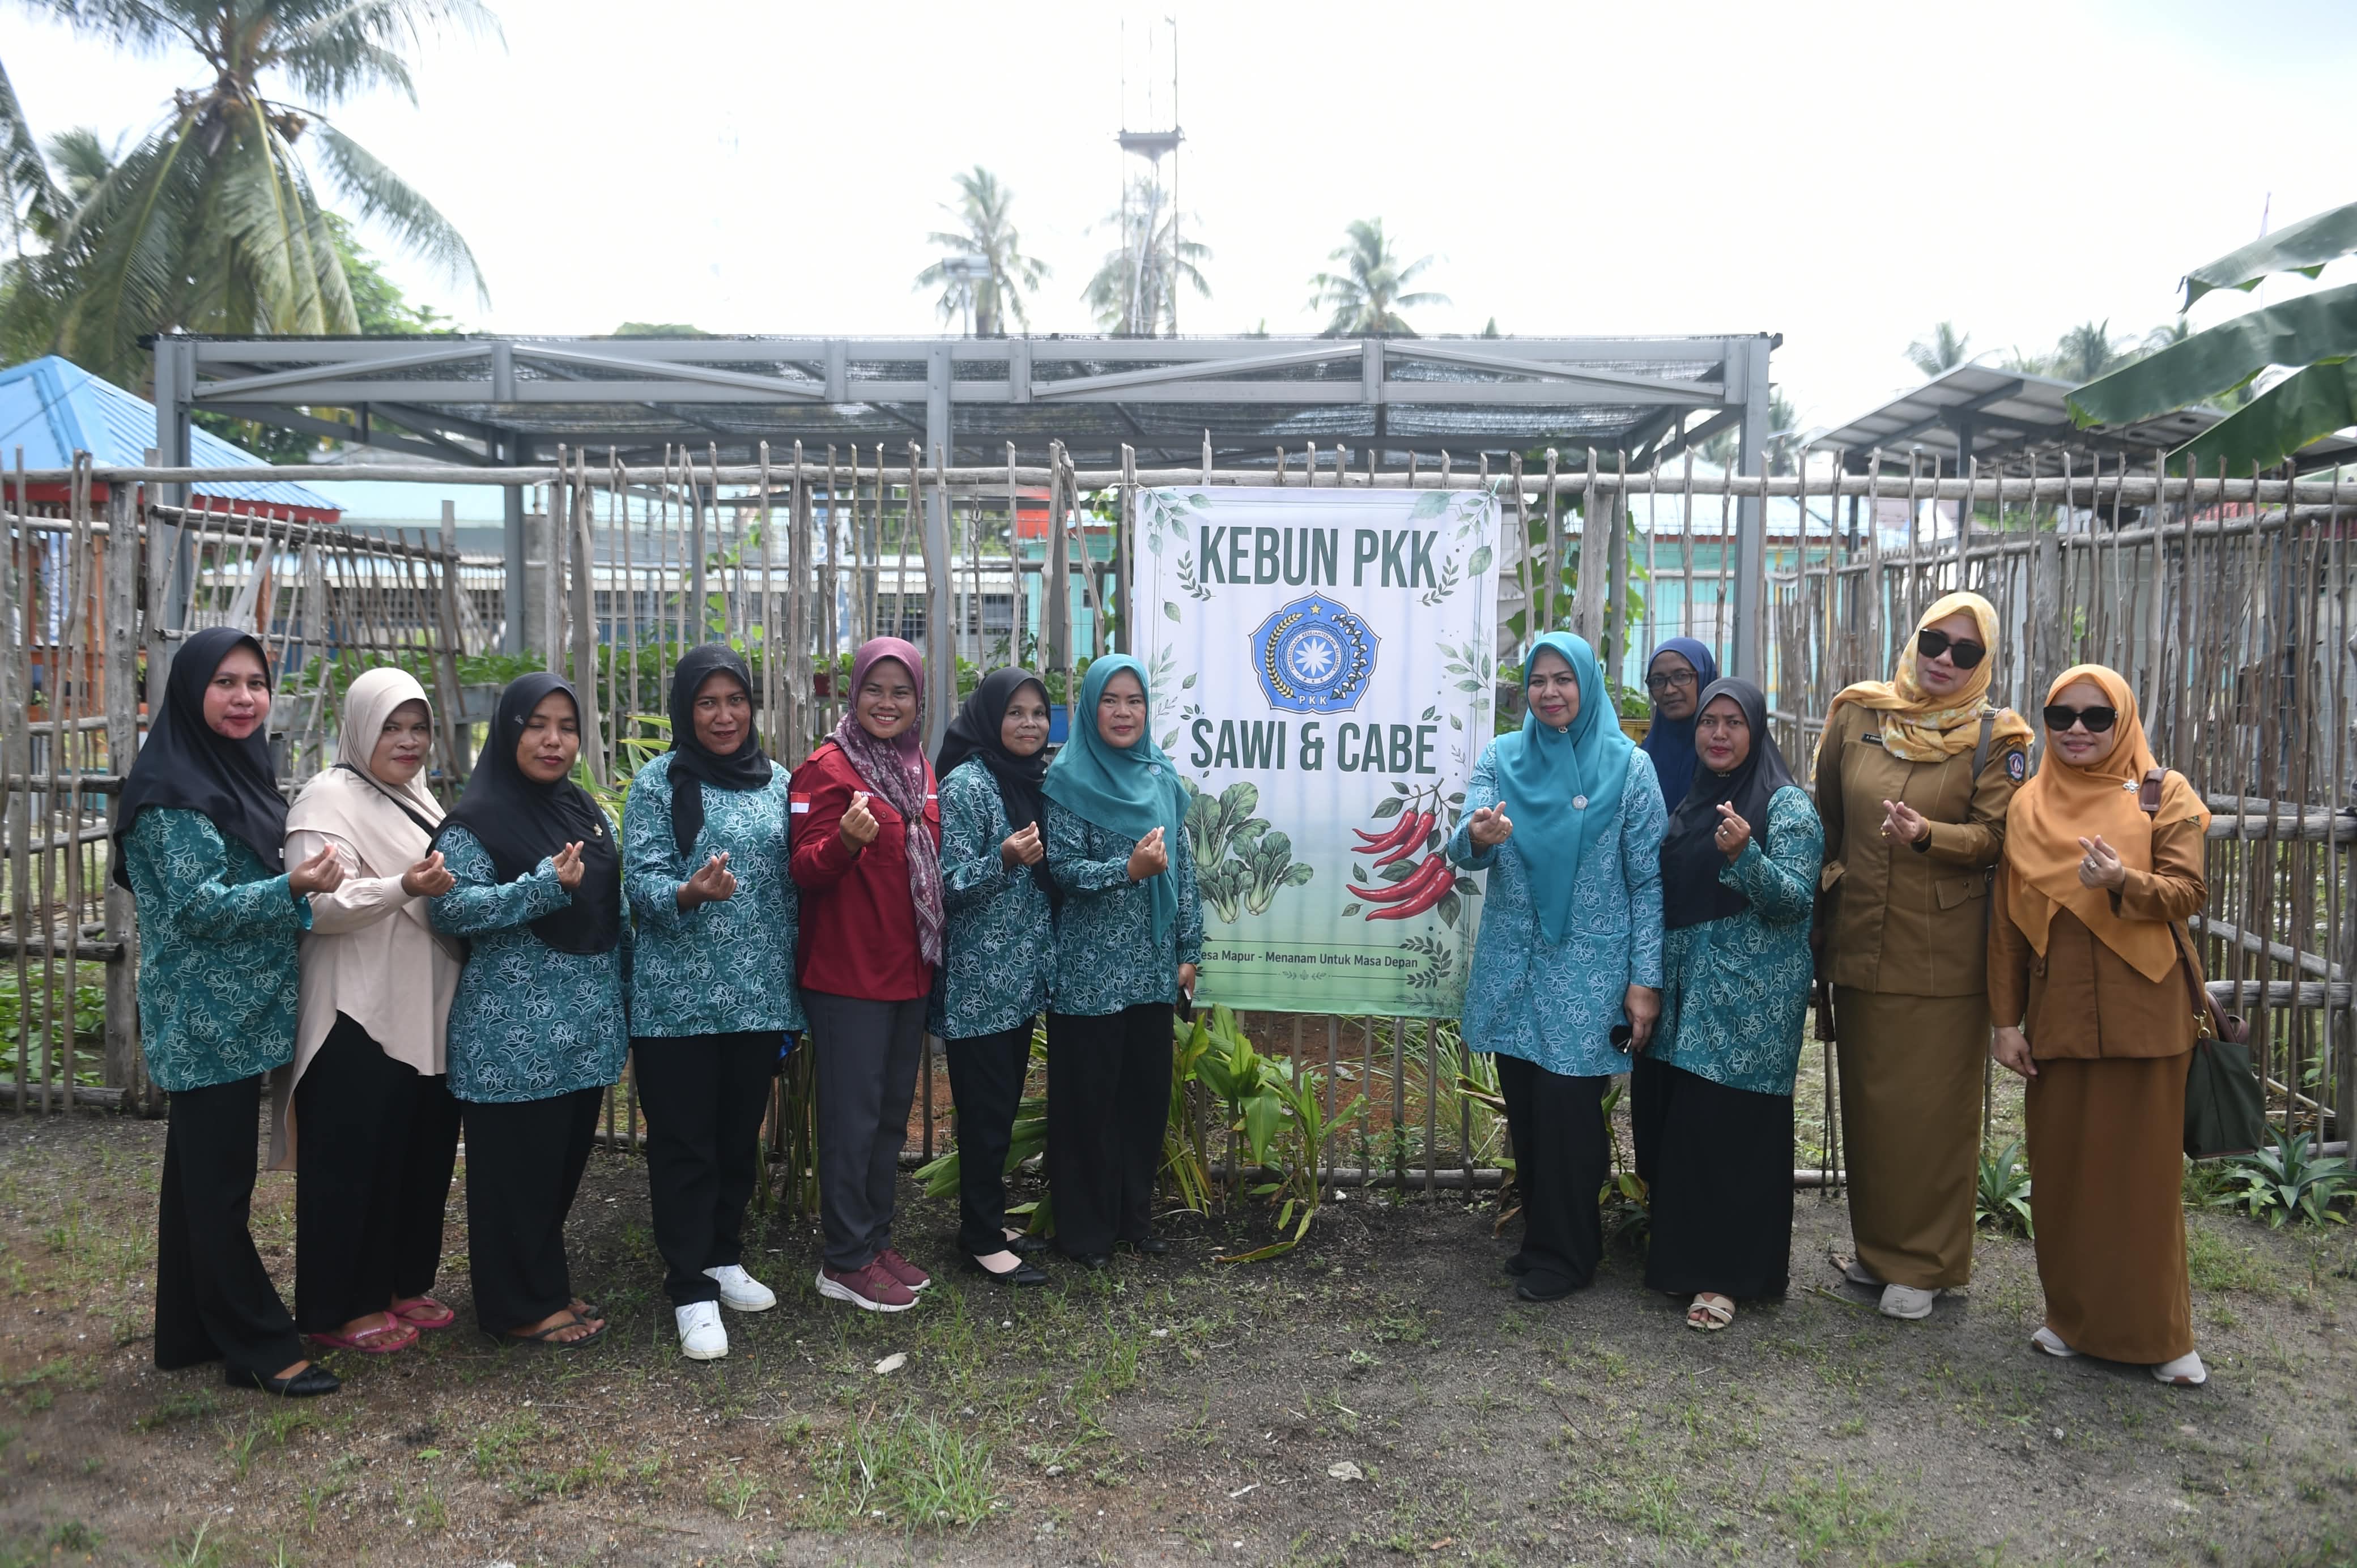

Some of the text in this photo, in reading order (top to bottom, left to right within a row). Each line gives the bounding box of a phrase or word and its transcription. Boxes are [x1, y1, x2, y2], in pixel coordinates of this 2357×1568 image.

[1198, 526, 1439, 589] KEBUN PKK
[1298, 695, 1328, 706] PKK
[1190, 718, 1438, 774] SAWI & CABE
[1201, 951, 1218, 960] esa
[1222, 950, 1255, 964] Mapur
[1265, 952, 1316, 964] Menanam
[1320, 953, 1351, 965] Untuk
[1354, 955, 1381, 966] Masa
[1385, 956, 1418, 969] Depan
